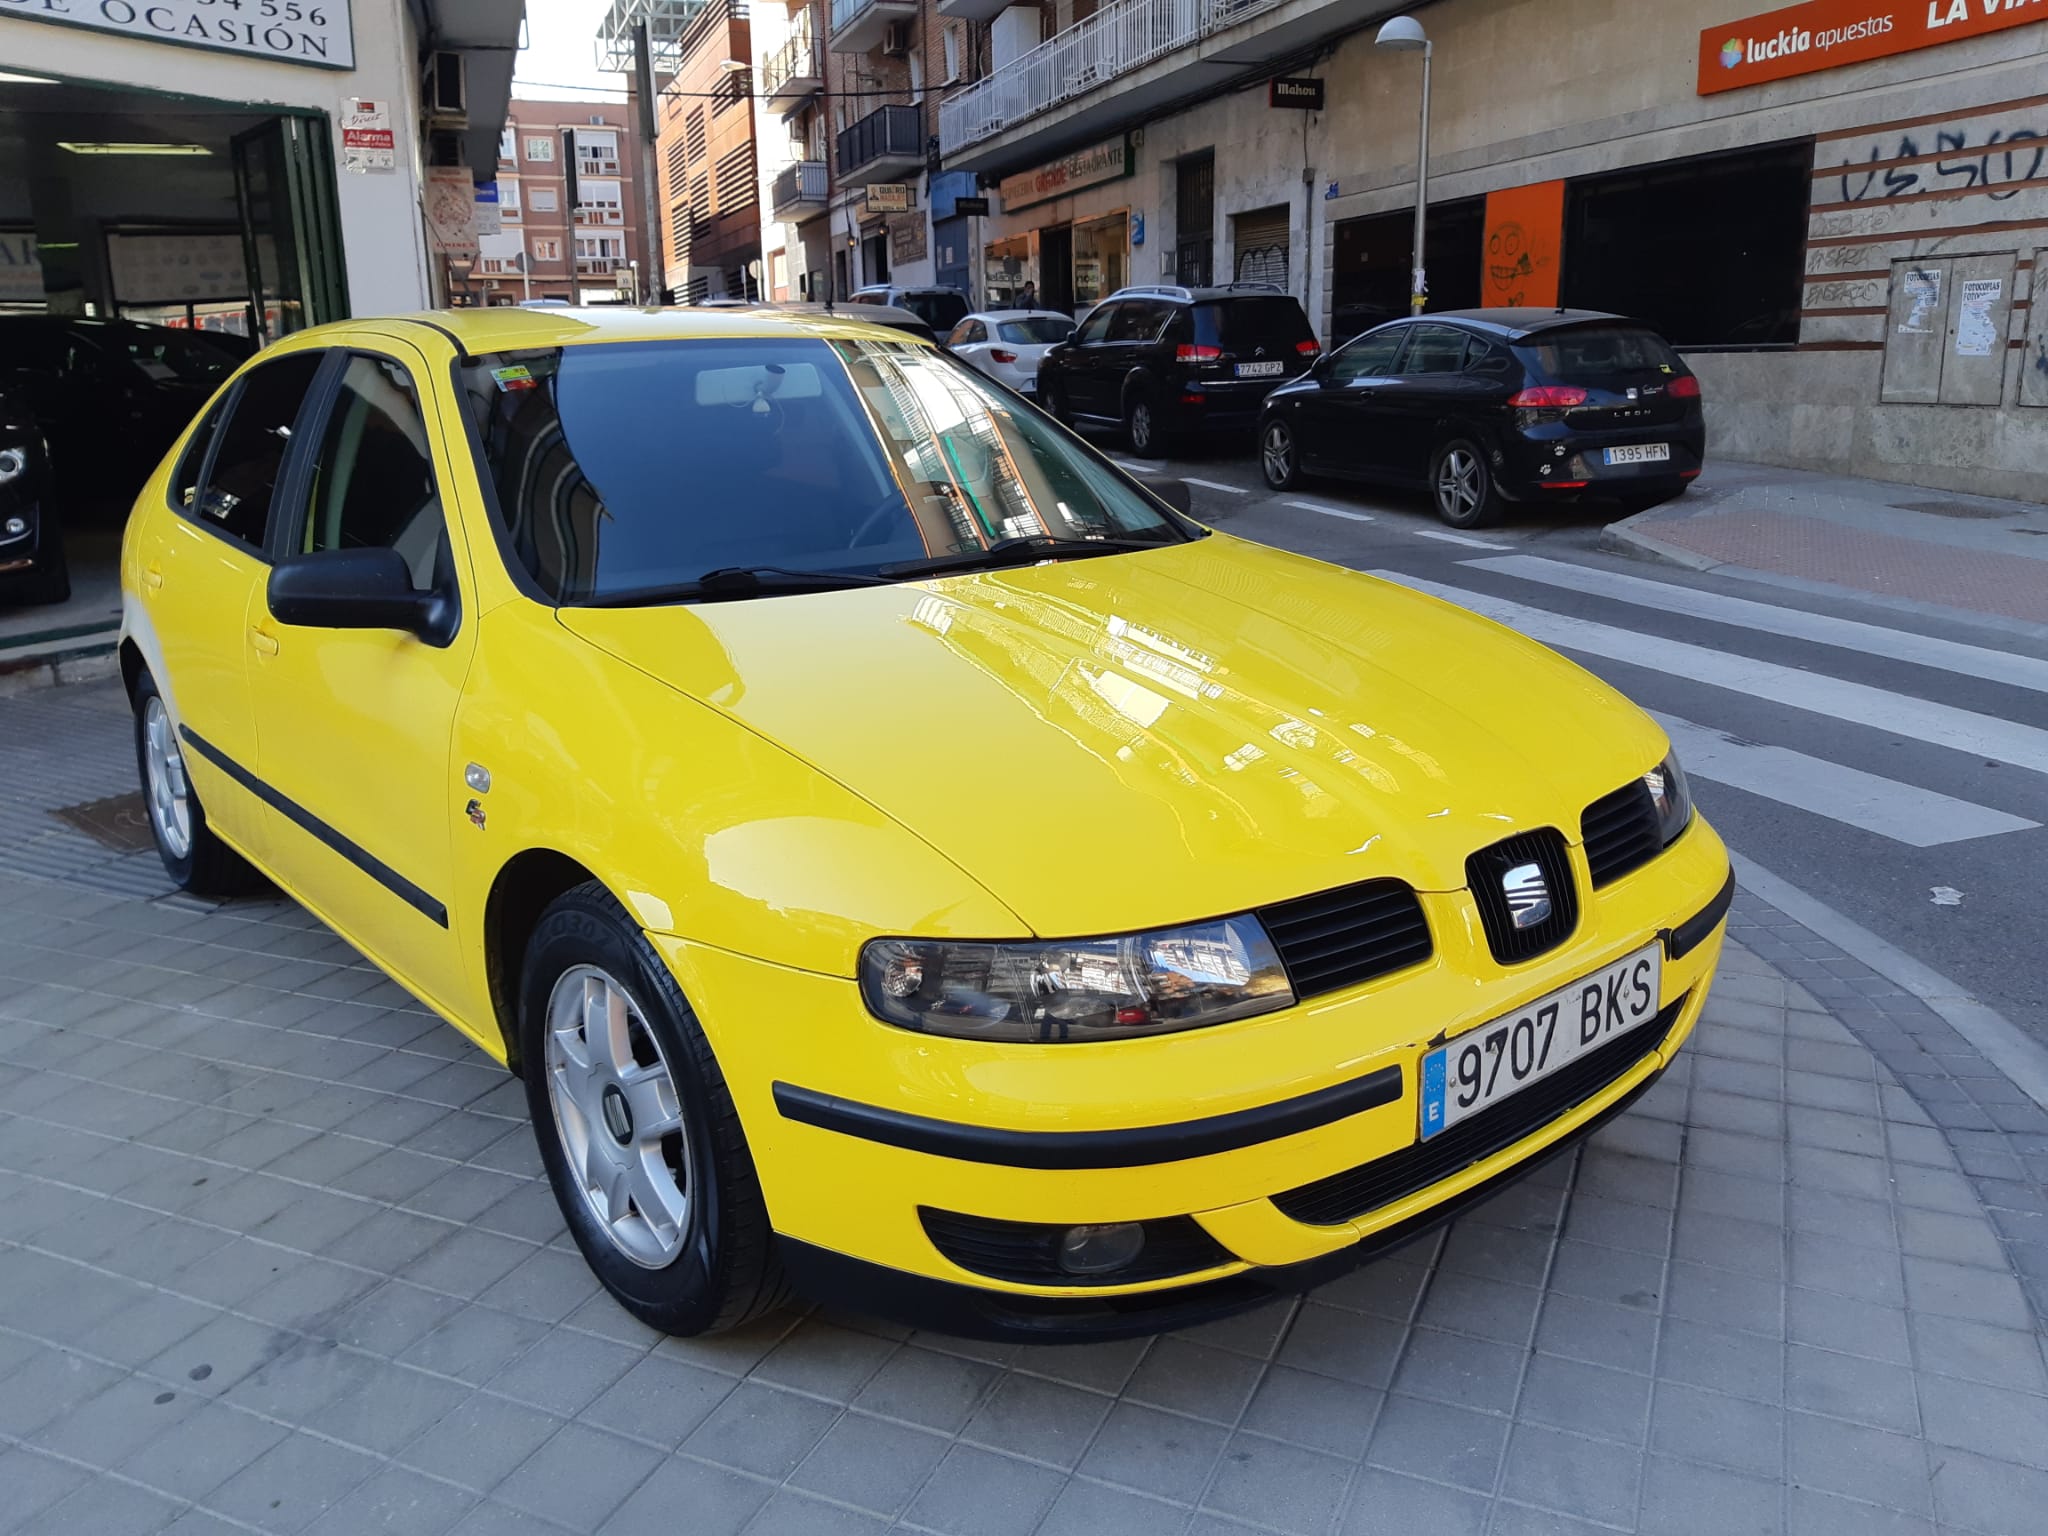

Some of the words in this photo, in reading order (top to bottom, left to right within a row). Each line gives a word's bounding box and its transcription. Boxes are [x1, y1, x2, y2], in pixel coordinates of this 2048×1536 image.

[260, 0, 327, 26] 556
[99, 0, 328, 58] OCASIÓN
[1747, 26, 1811, 63] luckia
[1815, 14, 1893, 51] apuestas
[1927, 0, 1968, 29] LA
[1277, 83, 1316, 96] Mahou
[346, 130, 391, 142] Alarma
[1964, 281, 2000, 292] FOTOCOPIAS
[1240, 363, 1262, 374] 7742
[1613, 409, 1651, 418] LEON
[1612, 447, 1642, 462] 1395
[1645, 444, 1668, 460] HFN
[1428, 1101, 1440, 1122] E
[1457, 1001, 1559, 1109] 9707
[1580, 958, 1651, 1047] BKS
